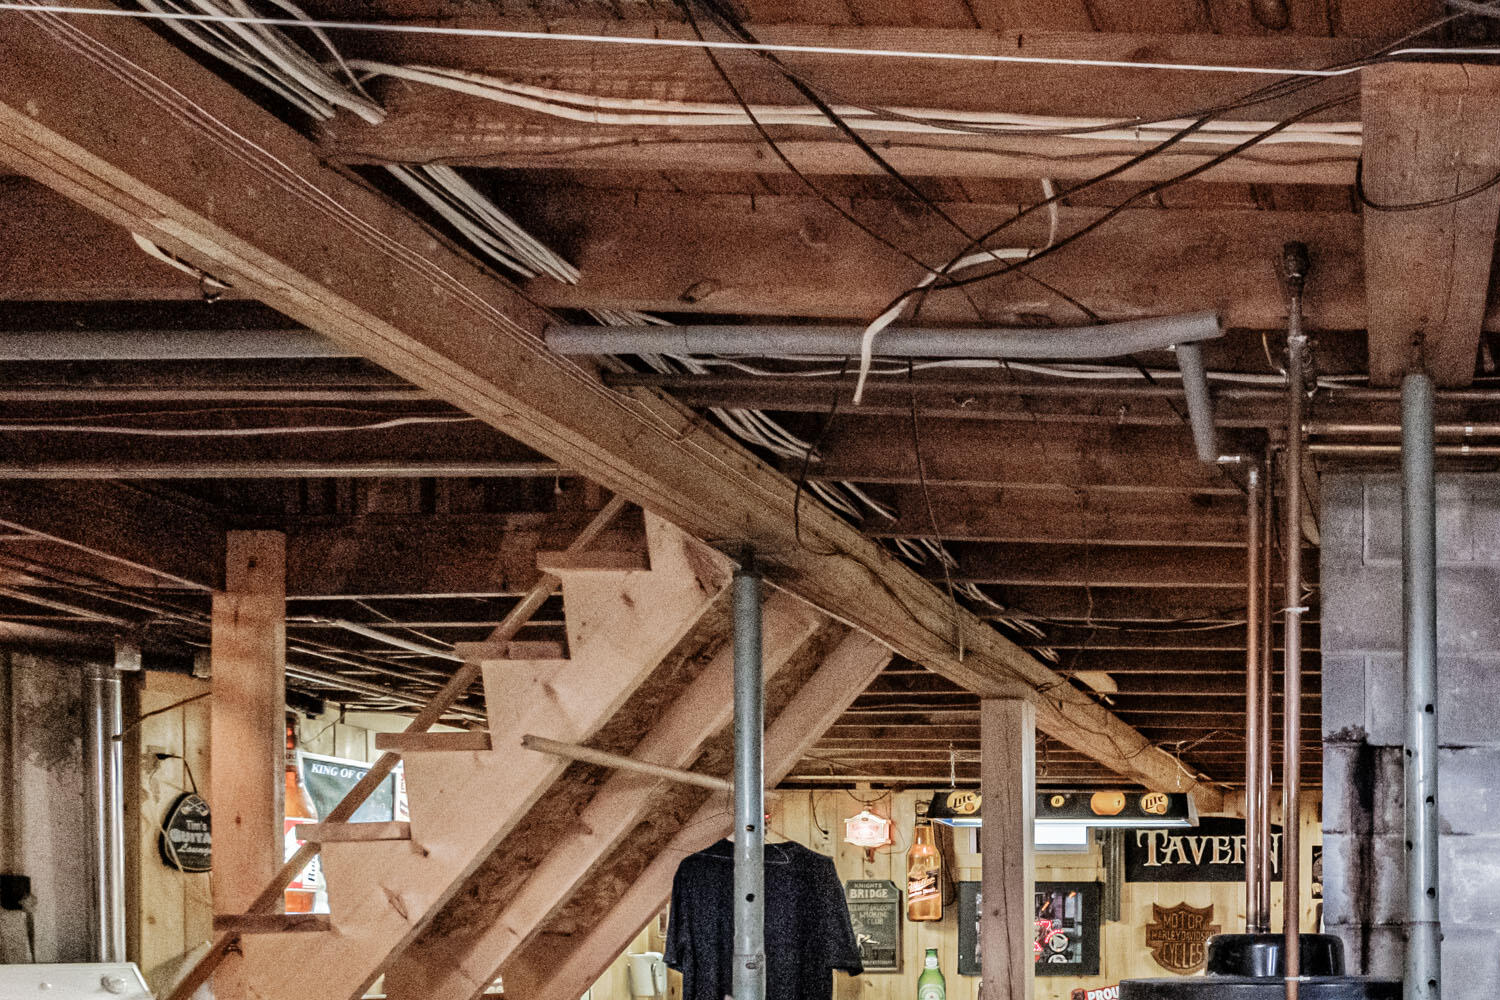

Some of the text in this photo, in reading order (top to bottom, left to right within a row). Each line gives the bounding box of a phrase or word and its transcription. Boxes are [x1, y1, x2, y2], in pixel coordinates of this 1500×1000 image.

[311, 763, 338, 777] KING
[340, 768, 356, 779] OF
[953, 795, 973, 808] Lite
[1145, 795, 1163, 810] Lite
[170, 828, 212, 844] GUITA
[849, 889, 889, 899] BRIDGE
[1163, 912, 1204, 929] MOTOR
[1163, 942, 1203, 968] CYCLES
